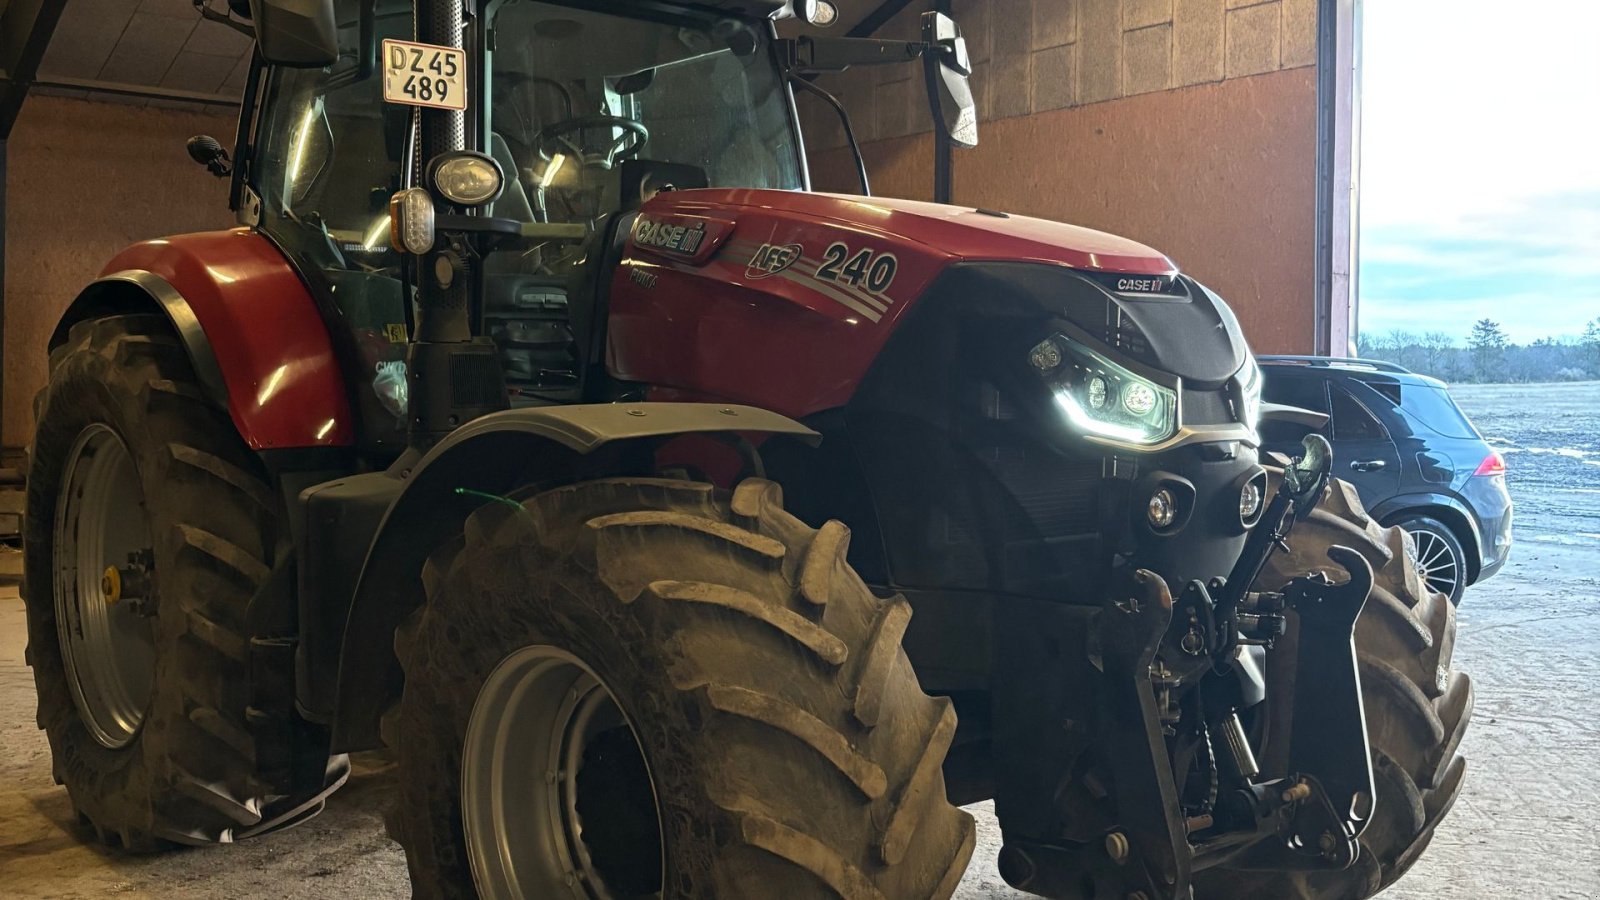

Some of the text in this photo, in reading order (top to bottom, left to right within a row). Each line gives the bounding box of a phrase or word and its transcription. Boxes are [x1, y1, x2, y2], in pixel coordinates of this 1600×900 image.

[403, 75, 448, 102] 489
[635, 220, 685, 249] CASE
[752, 243, 789, 271] AFS
[815, 241, 897, 295] 240
[1118, 279, 1151, 291] CASE
